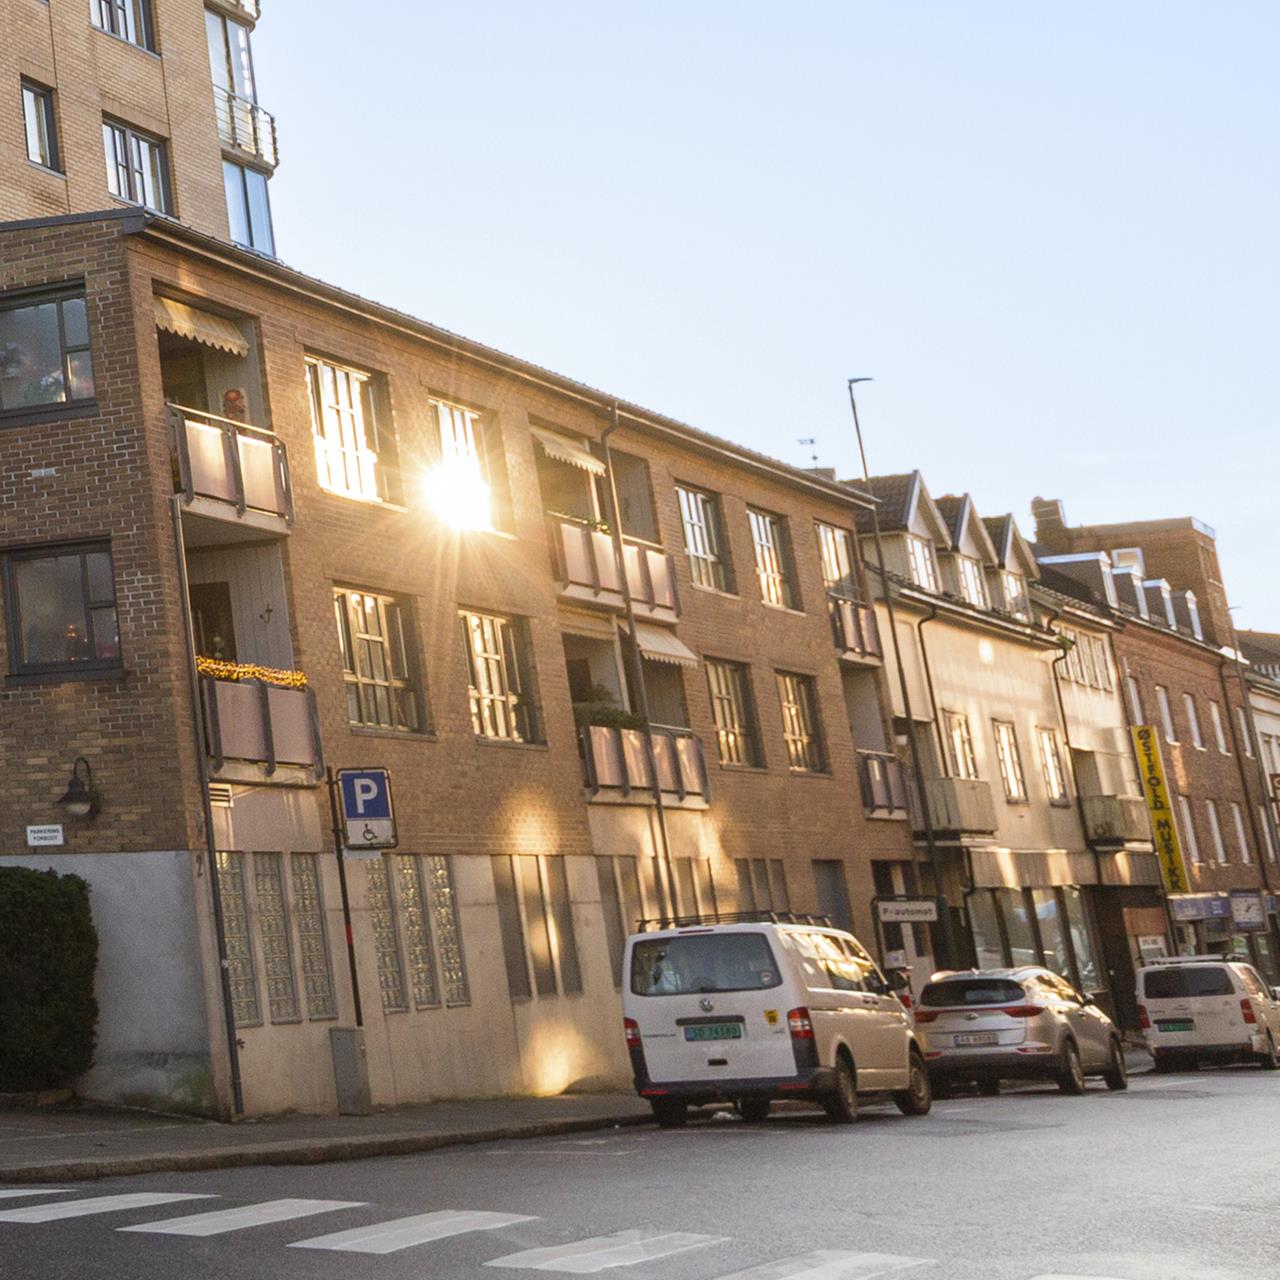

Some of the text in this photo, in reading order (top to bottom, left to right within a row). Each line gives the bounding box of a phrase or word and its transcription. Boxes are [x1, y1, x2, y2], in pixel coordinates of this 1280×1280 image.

[353, 778, 378, 814] P
[1138, 729, 1181, 890] ØSTFOLD MUSIKK
[882, 907, 933, 916] P-automat
